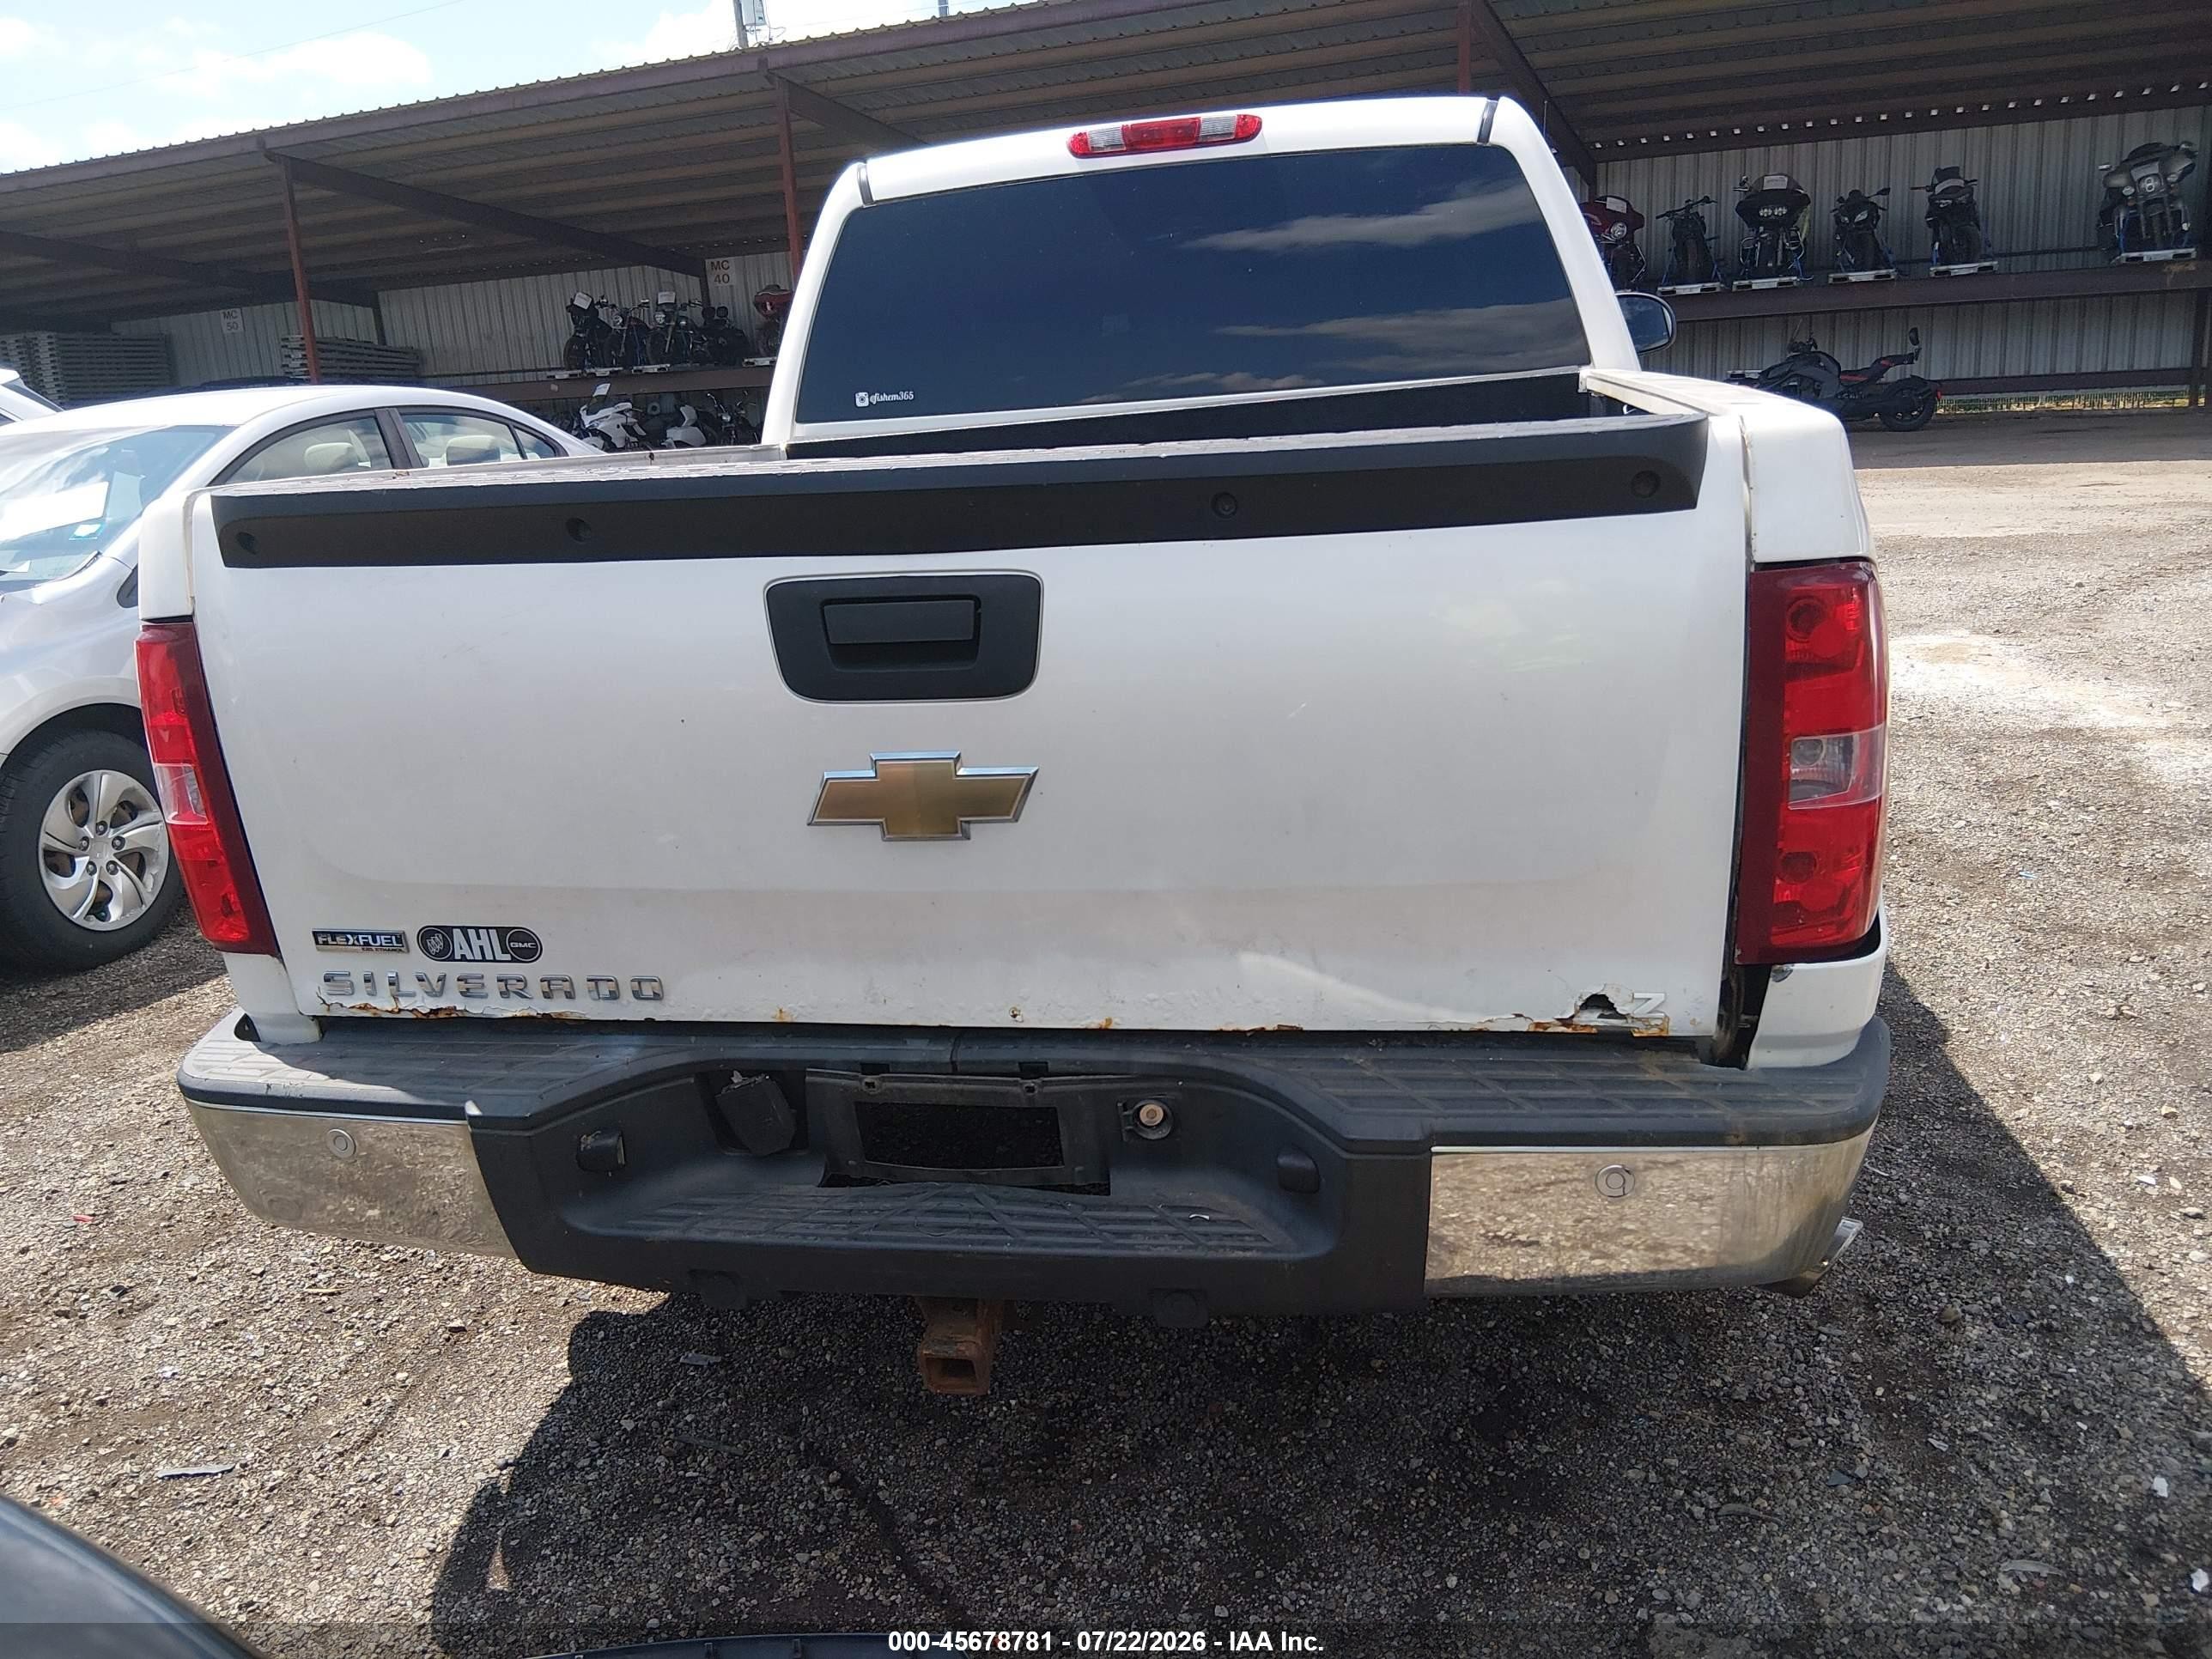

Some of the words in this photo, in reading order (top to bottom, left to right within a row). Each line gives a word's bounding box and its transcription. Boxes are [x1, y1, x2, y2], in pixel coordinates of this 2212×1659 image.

[711, 260, 729, 270] MC
[714, 274, 729, 283] 40
[222, 309, 238, 320] MC
[227, 322, 238, 331] 50
[316, 933, 403, 947] FLEXFUEL
[453, 928, 512, 961] AHL
[322, 969, 665, 1001] SILVERADO
